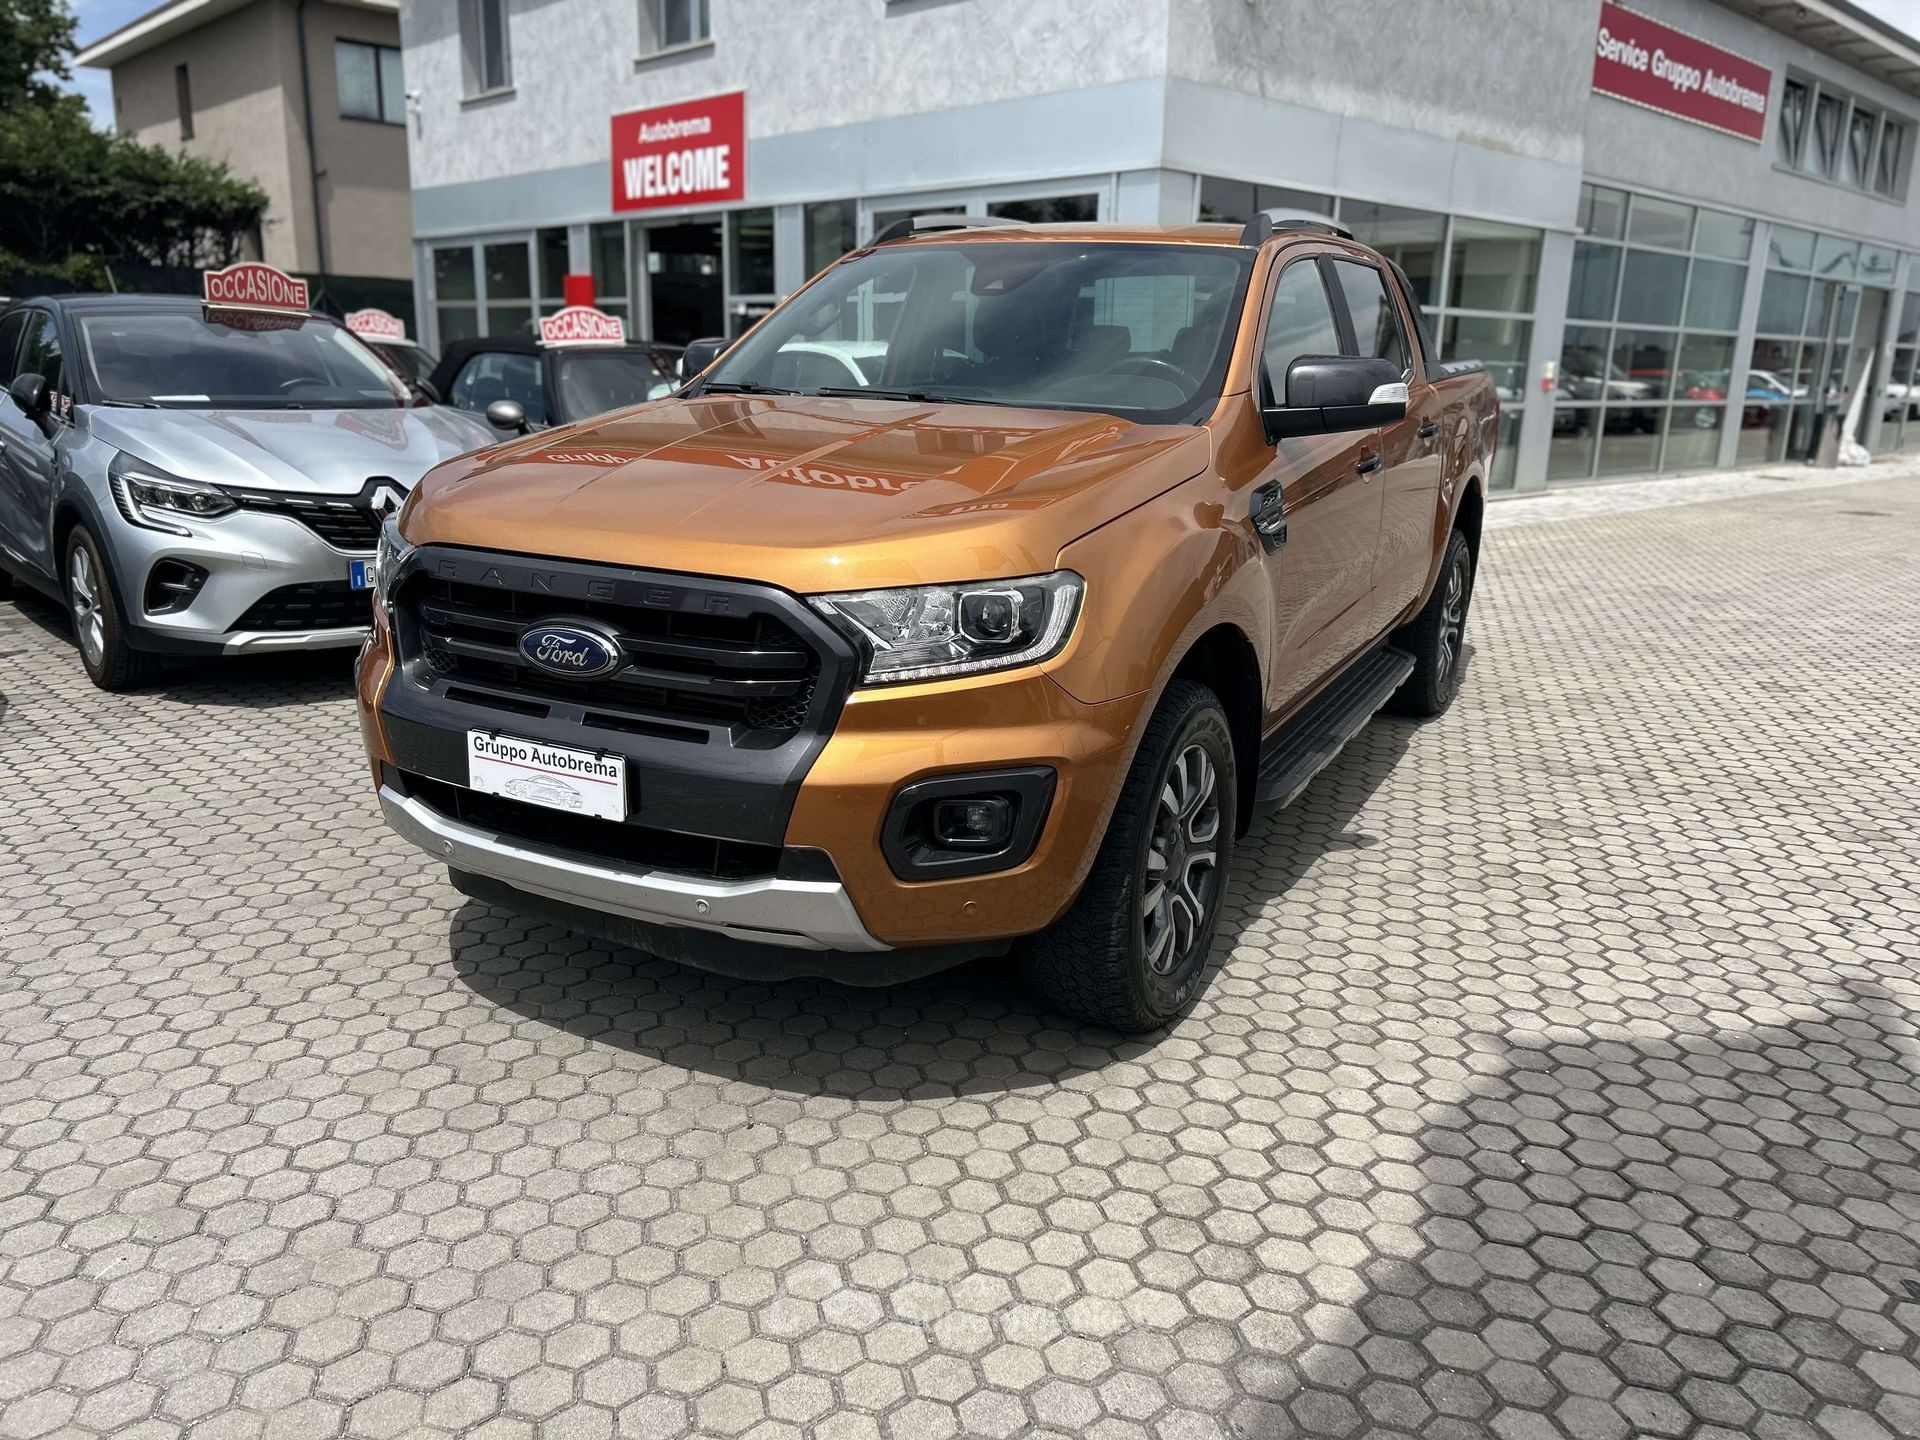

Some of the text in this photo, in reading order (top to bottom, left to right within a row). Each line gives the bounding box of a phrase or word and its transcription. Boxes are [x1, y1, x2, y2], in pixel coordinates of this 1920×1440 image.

[1597, 27, 1766, 114] Service Gruppo Autobrema
[637, 115, 711, 144] Autobrema
[623, 144, 730, 200] WELCOME
[210, 269, 305, 305] OCCASIONE
[544, 311, 620, 339] OCCASIONE
[437, 559, 738, 614] RANGER
[536, 633, 590, 667] Ford
[473, 735, 619, 778] Gruppo Autobrema
